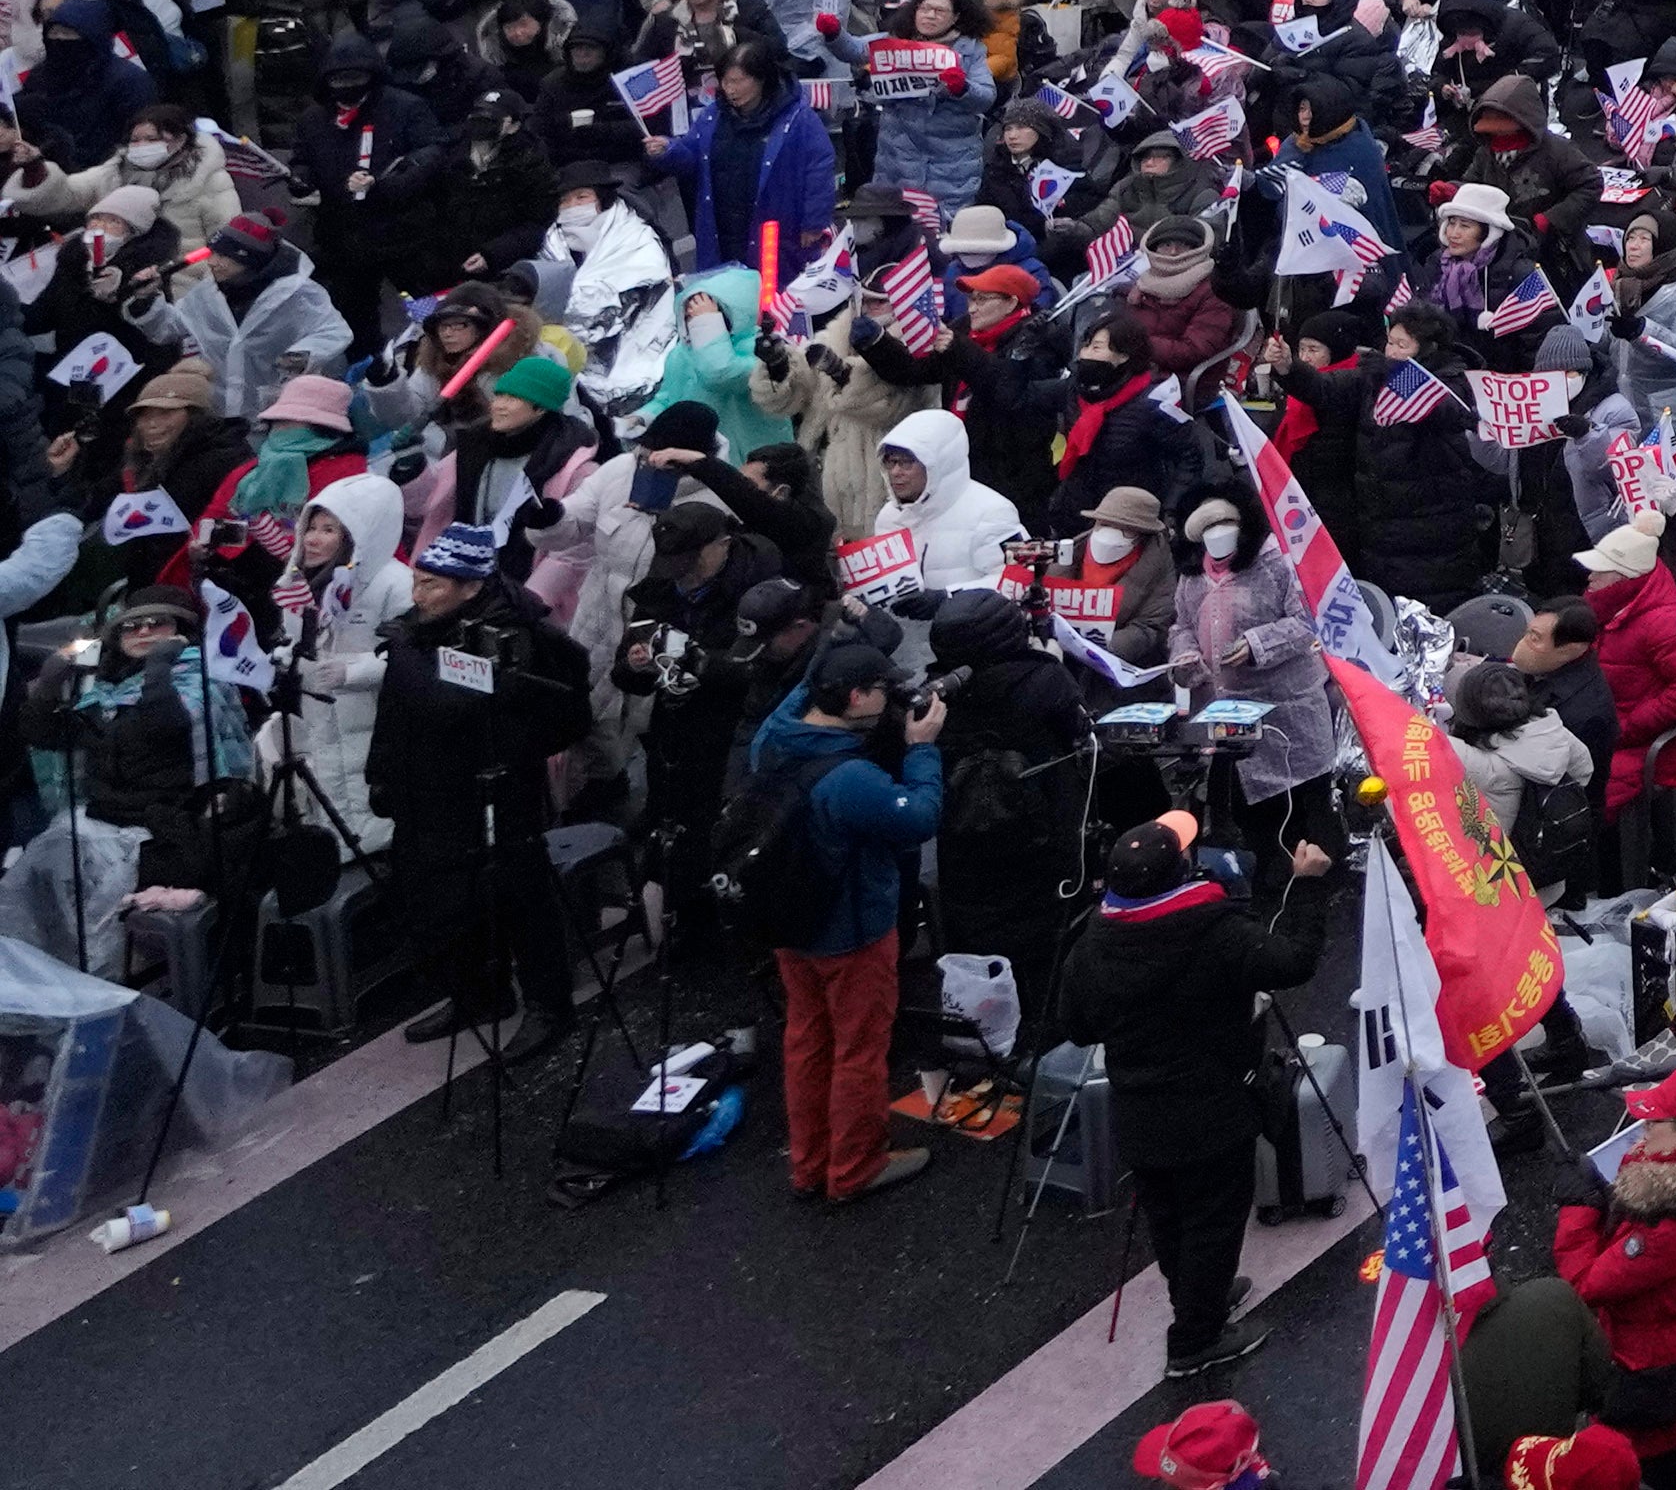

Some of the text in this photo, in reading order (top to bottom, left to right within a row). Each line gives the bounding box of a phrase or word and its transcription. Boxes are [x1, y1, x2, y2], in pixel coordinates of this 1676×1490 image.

[873, 44, 957, 71] 탄핵반대
[1483, 376, 1551, 401] STOP
[1492, 402, 1542, 424] THE
